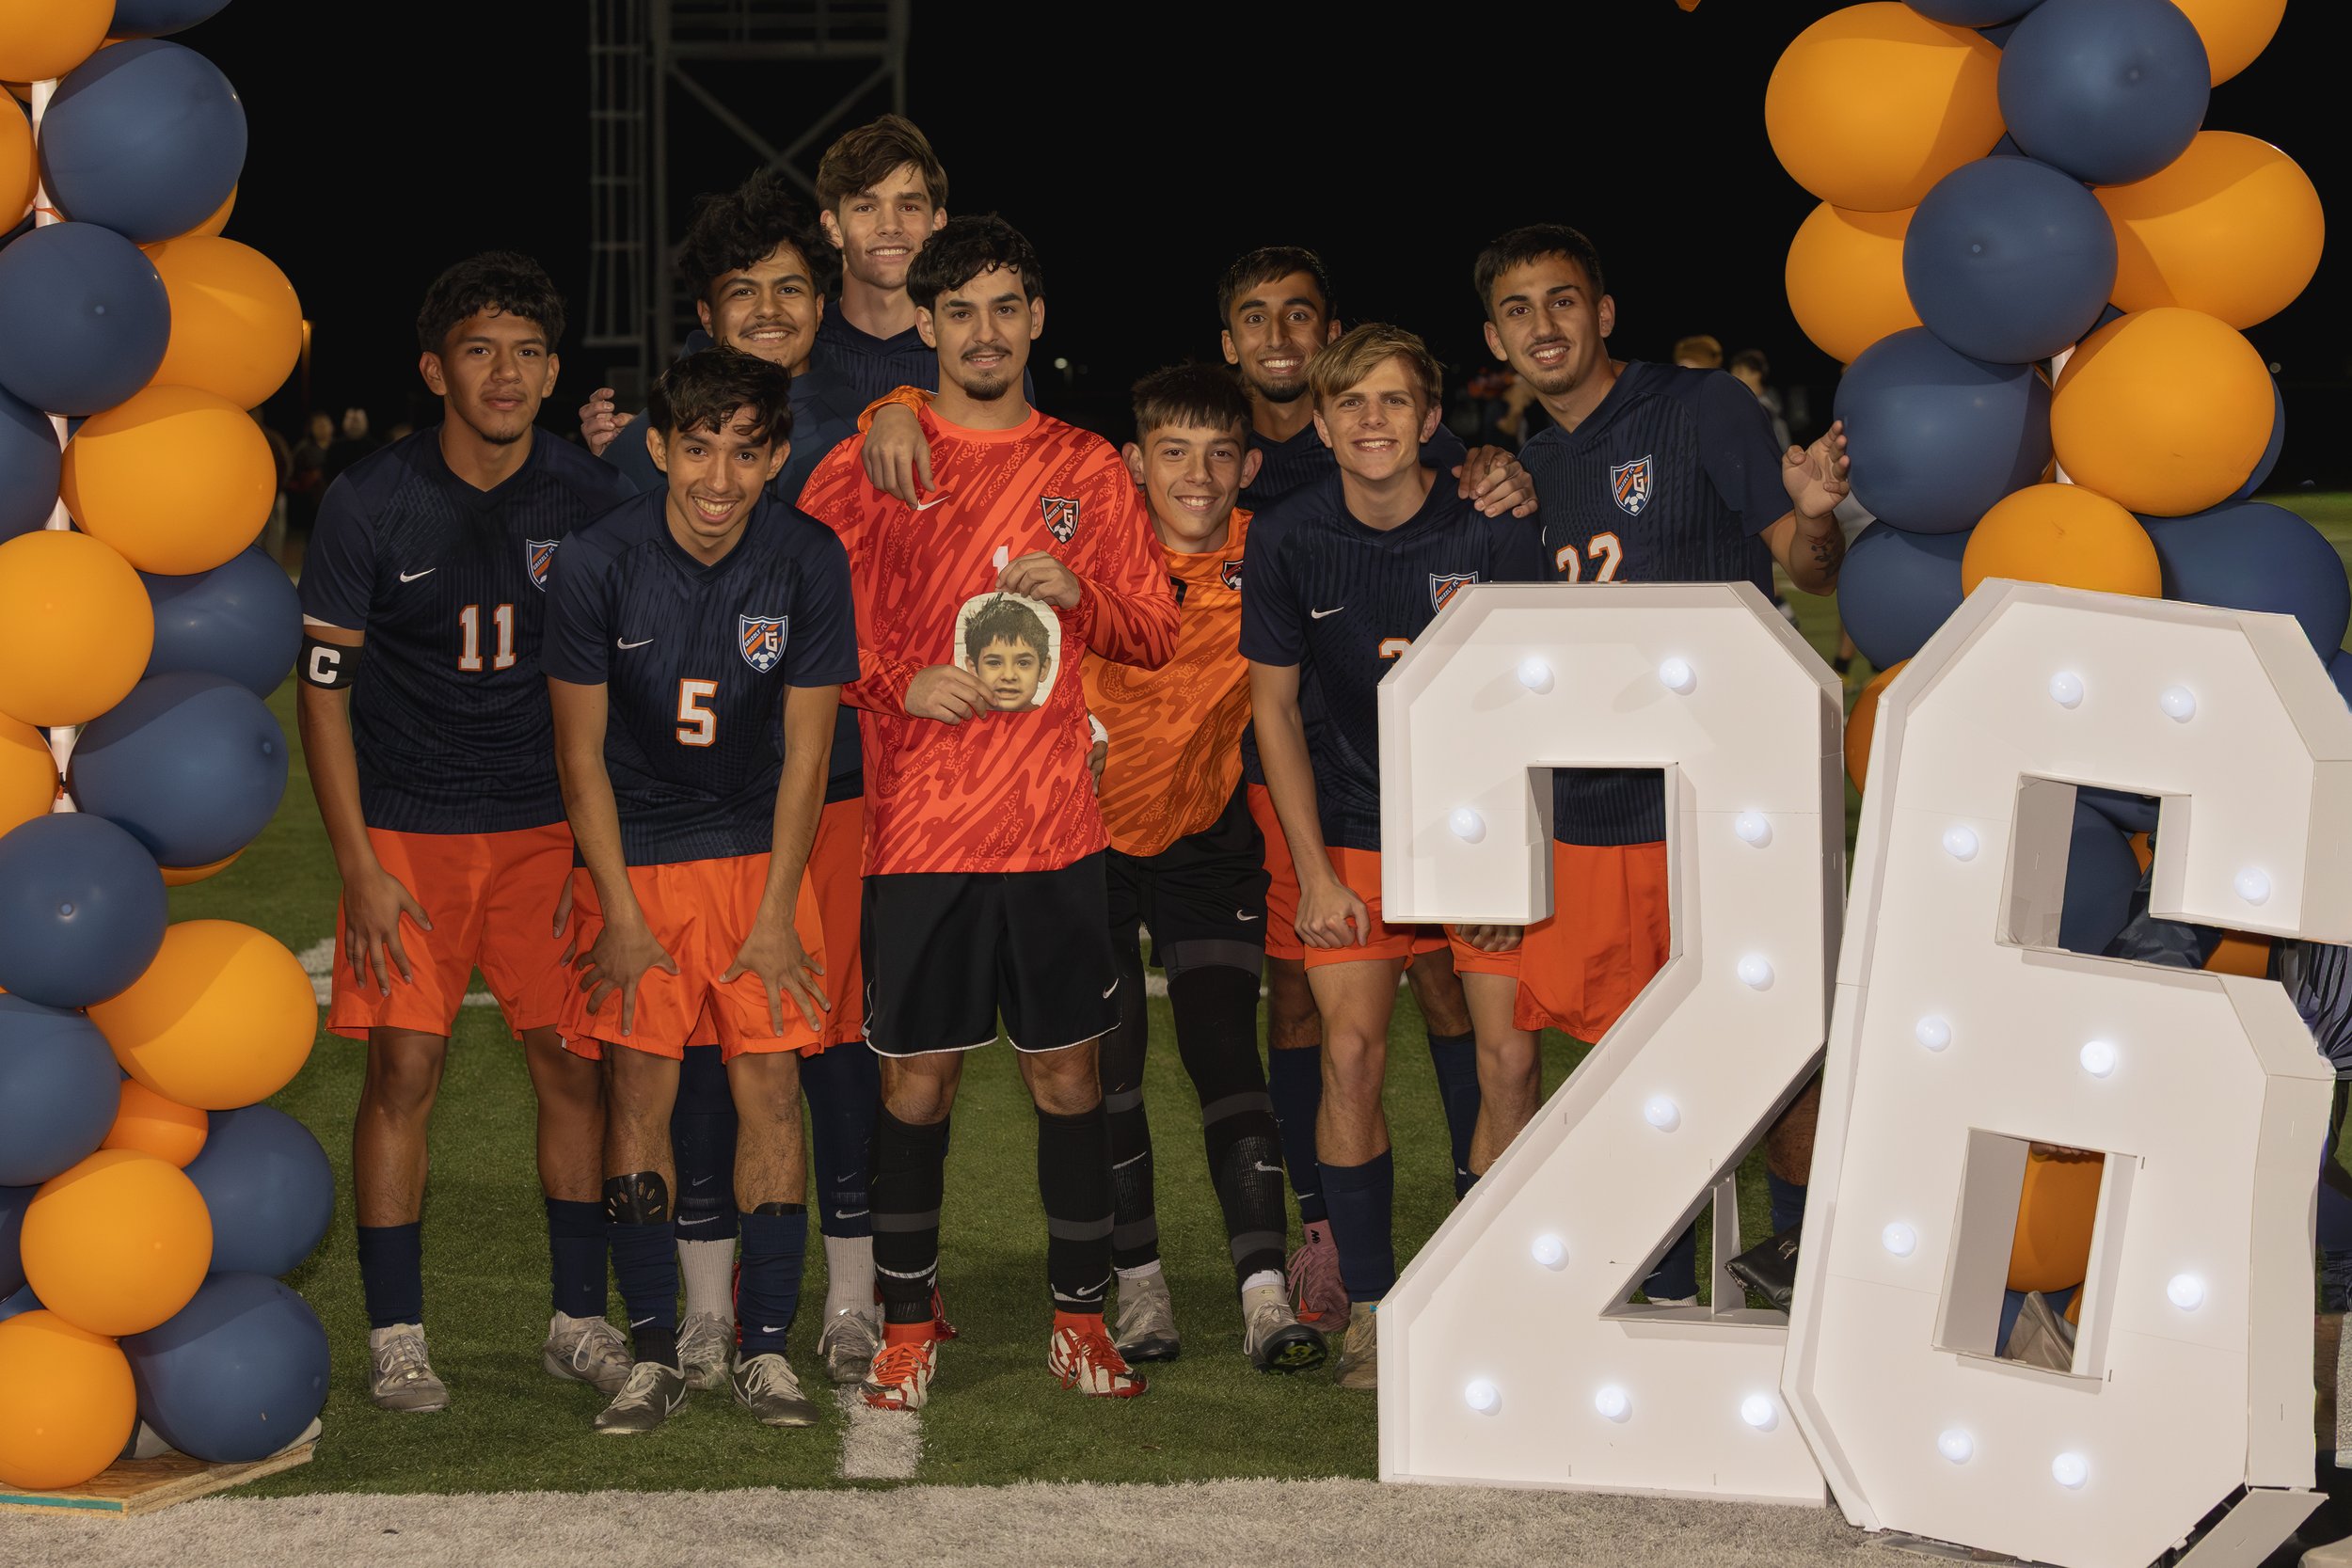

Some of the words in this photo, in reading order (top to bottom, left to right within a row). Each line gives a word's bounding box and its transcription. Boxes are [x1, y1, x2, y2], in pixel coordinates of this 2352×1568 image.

[1616, 474, 1629, 494] GRIZZLY
[1632, 471, 1645, 493] G
[1063, 508, 1073, 529] G
[532, 552, 548, 570] GRIZZLY
[1556, 531, 1625, 583] 22
[1437, 586, 1453, 604] GRIZZLY
[458, 604, 516, 671] 11
[744, 629, 761, 647] GRIZZLY
[765, 631, 778, 653] G
[310, 646, 341, 684] C
[675, 678, 719, 747] 5
[1377, 577, 2352, 1568] 26
